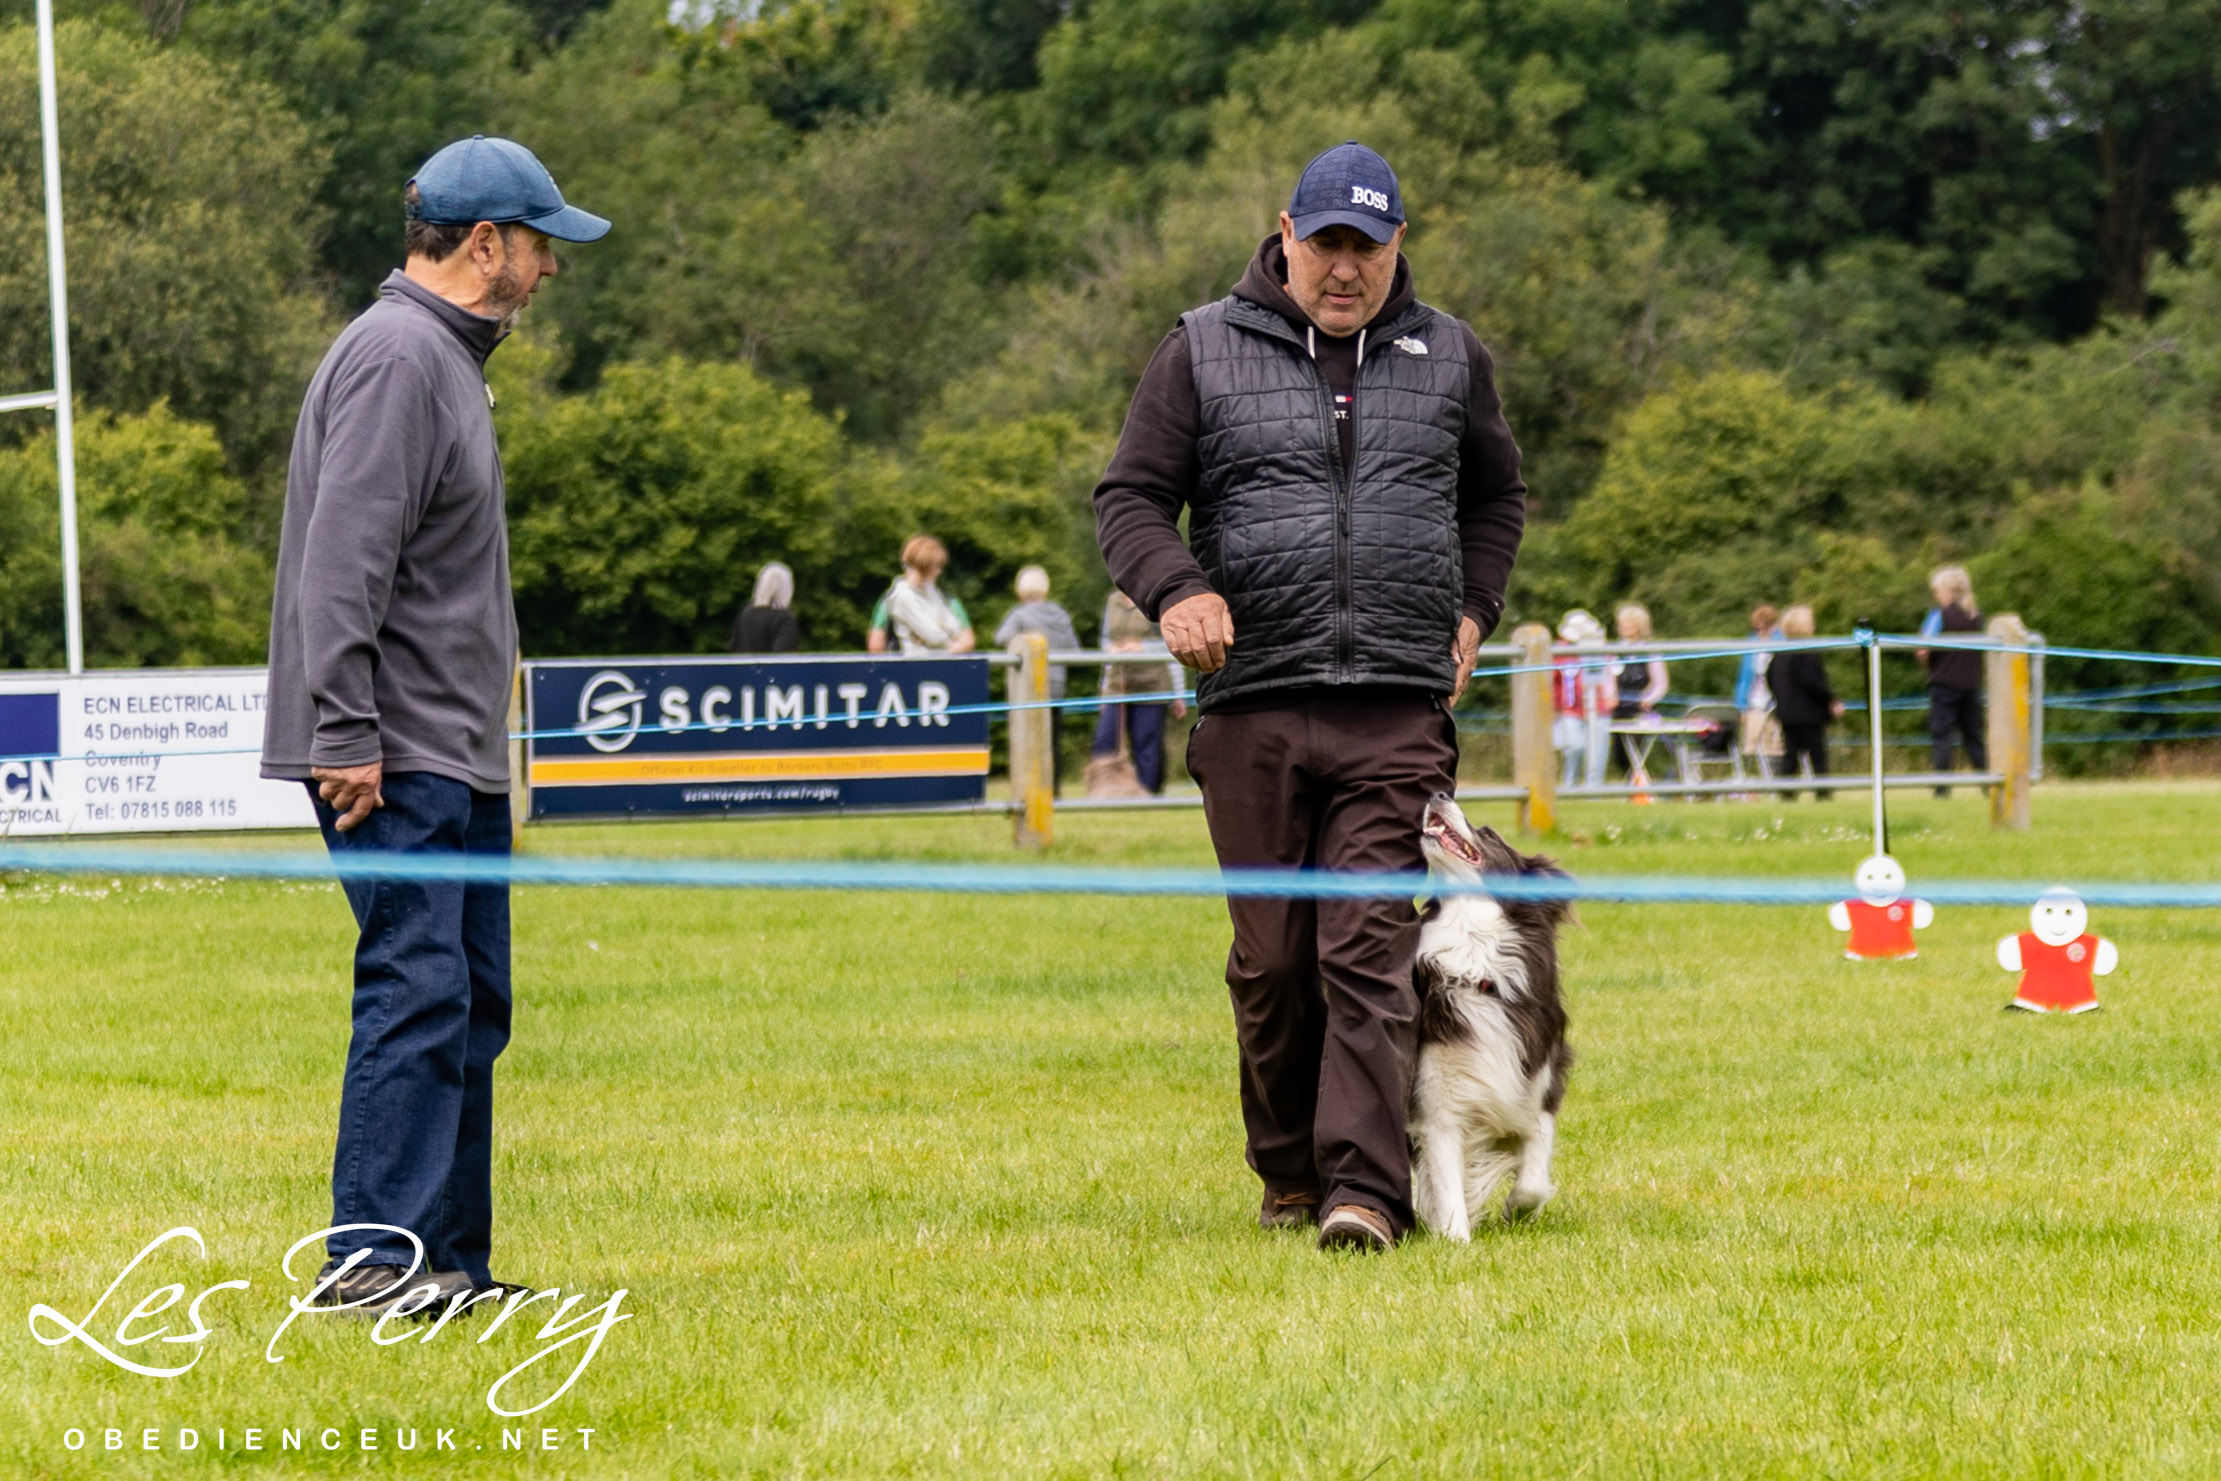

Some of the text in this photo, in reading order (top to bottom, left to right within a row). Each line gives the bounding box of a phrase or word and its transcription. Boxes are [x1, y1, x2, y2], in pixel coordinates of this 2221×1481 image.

[1351, 185, 1389, 212] BOSS
[84, 694, 267, 714] ECN ELECTRICAL LT
[659, 681, 950, 733] SCIMITAR
[84, 722, 228, 743] 45 Denbigh Road
[85, 751, 161, 771] Coventry
[85, 776, 156, 794] CV6 1FZ
[86, 799, 237, 820] Tel: 07815 088 115
